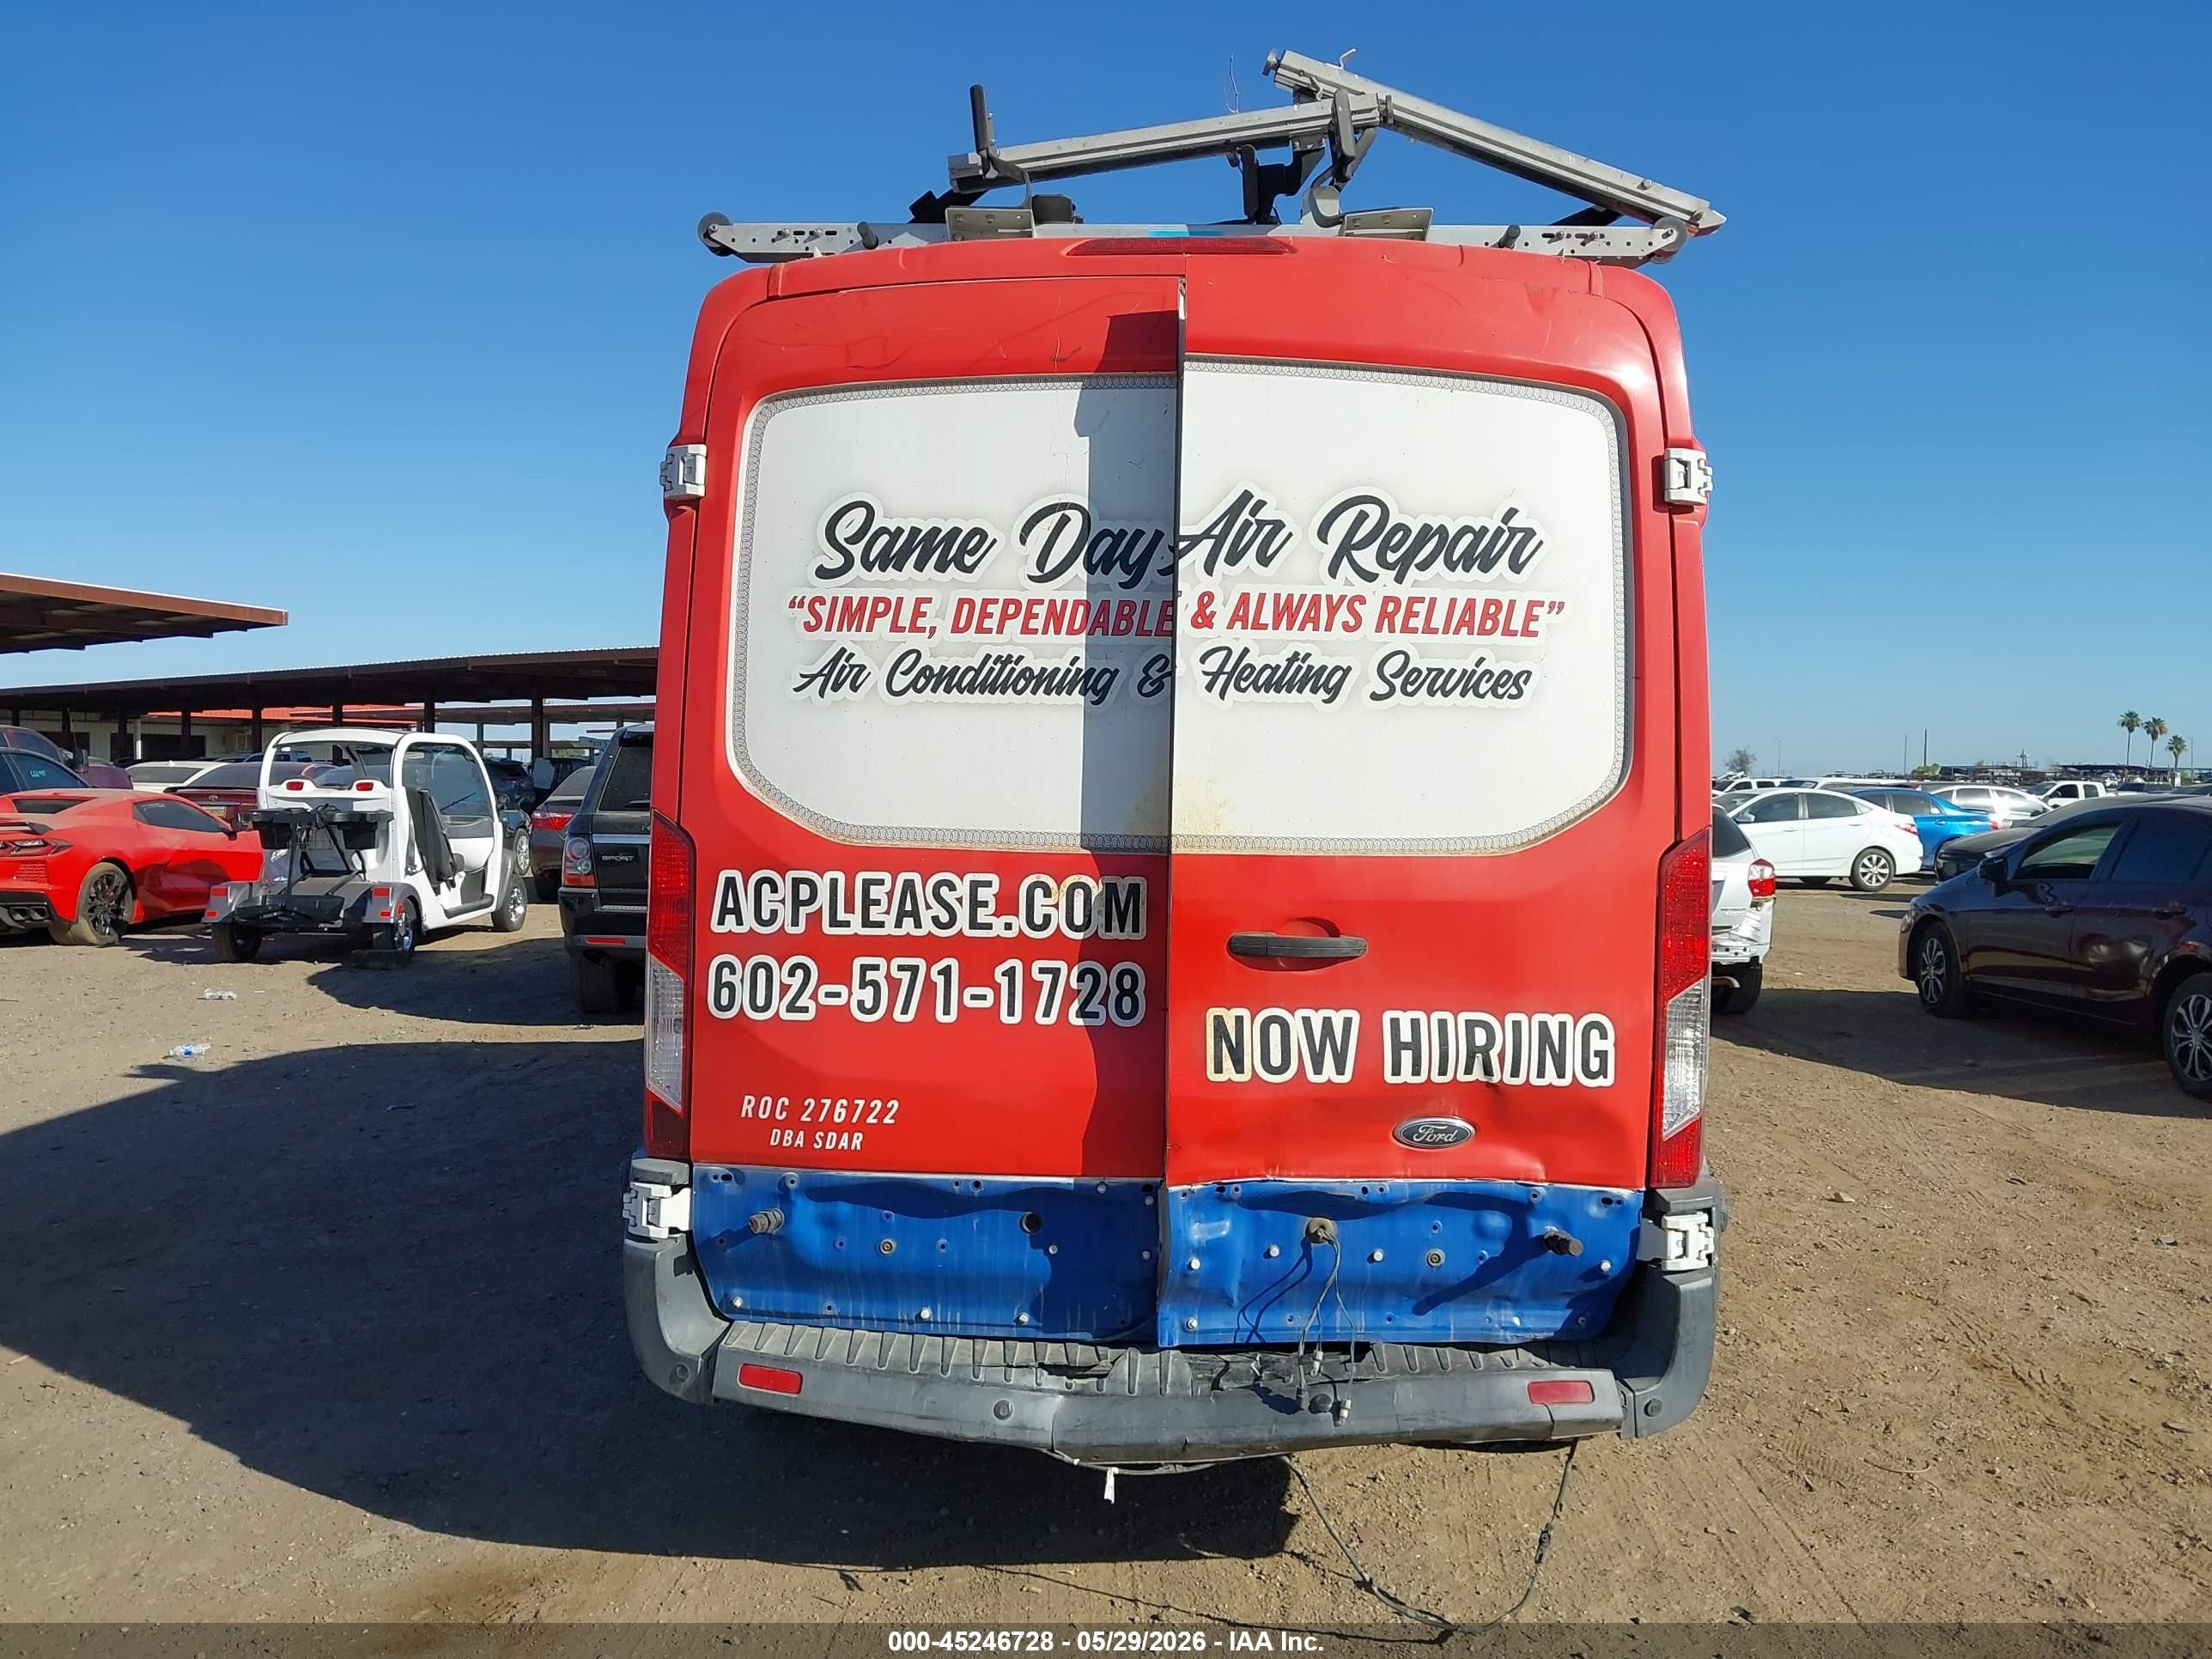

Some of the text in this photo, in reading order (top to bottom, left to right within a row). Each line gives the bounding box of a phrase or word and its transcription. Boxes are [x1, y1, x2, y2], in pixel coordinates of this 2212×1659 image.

[814, 489, 1544, 590] Same Day Air Repair
[788, 590, 1565, 640] “SIMPLE, DEPENDABLE & ALWAYS RELIABLE”
[793, 645, 1533, 707] Air Conditioning & Heating Services
[714, 874, 1143, 936] ACPLEASE.COM
[711, 958, 1142, 1022] 602-571-1728
[1211, 1012, 1611, 1082] NOW HIRING
[740, 1094, 900, 1125] ROC 276722
[769, 1127, 864, 1152] DBA SDAR
[1412, 1123, 1459, 1143] Ford
